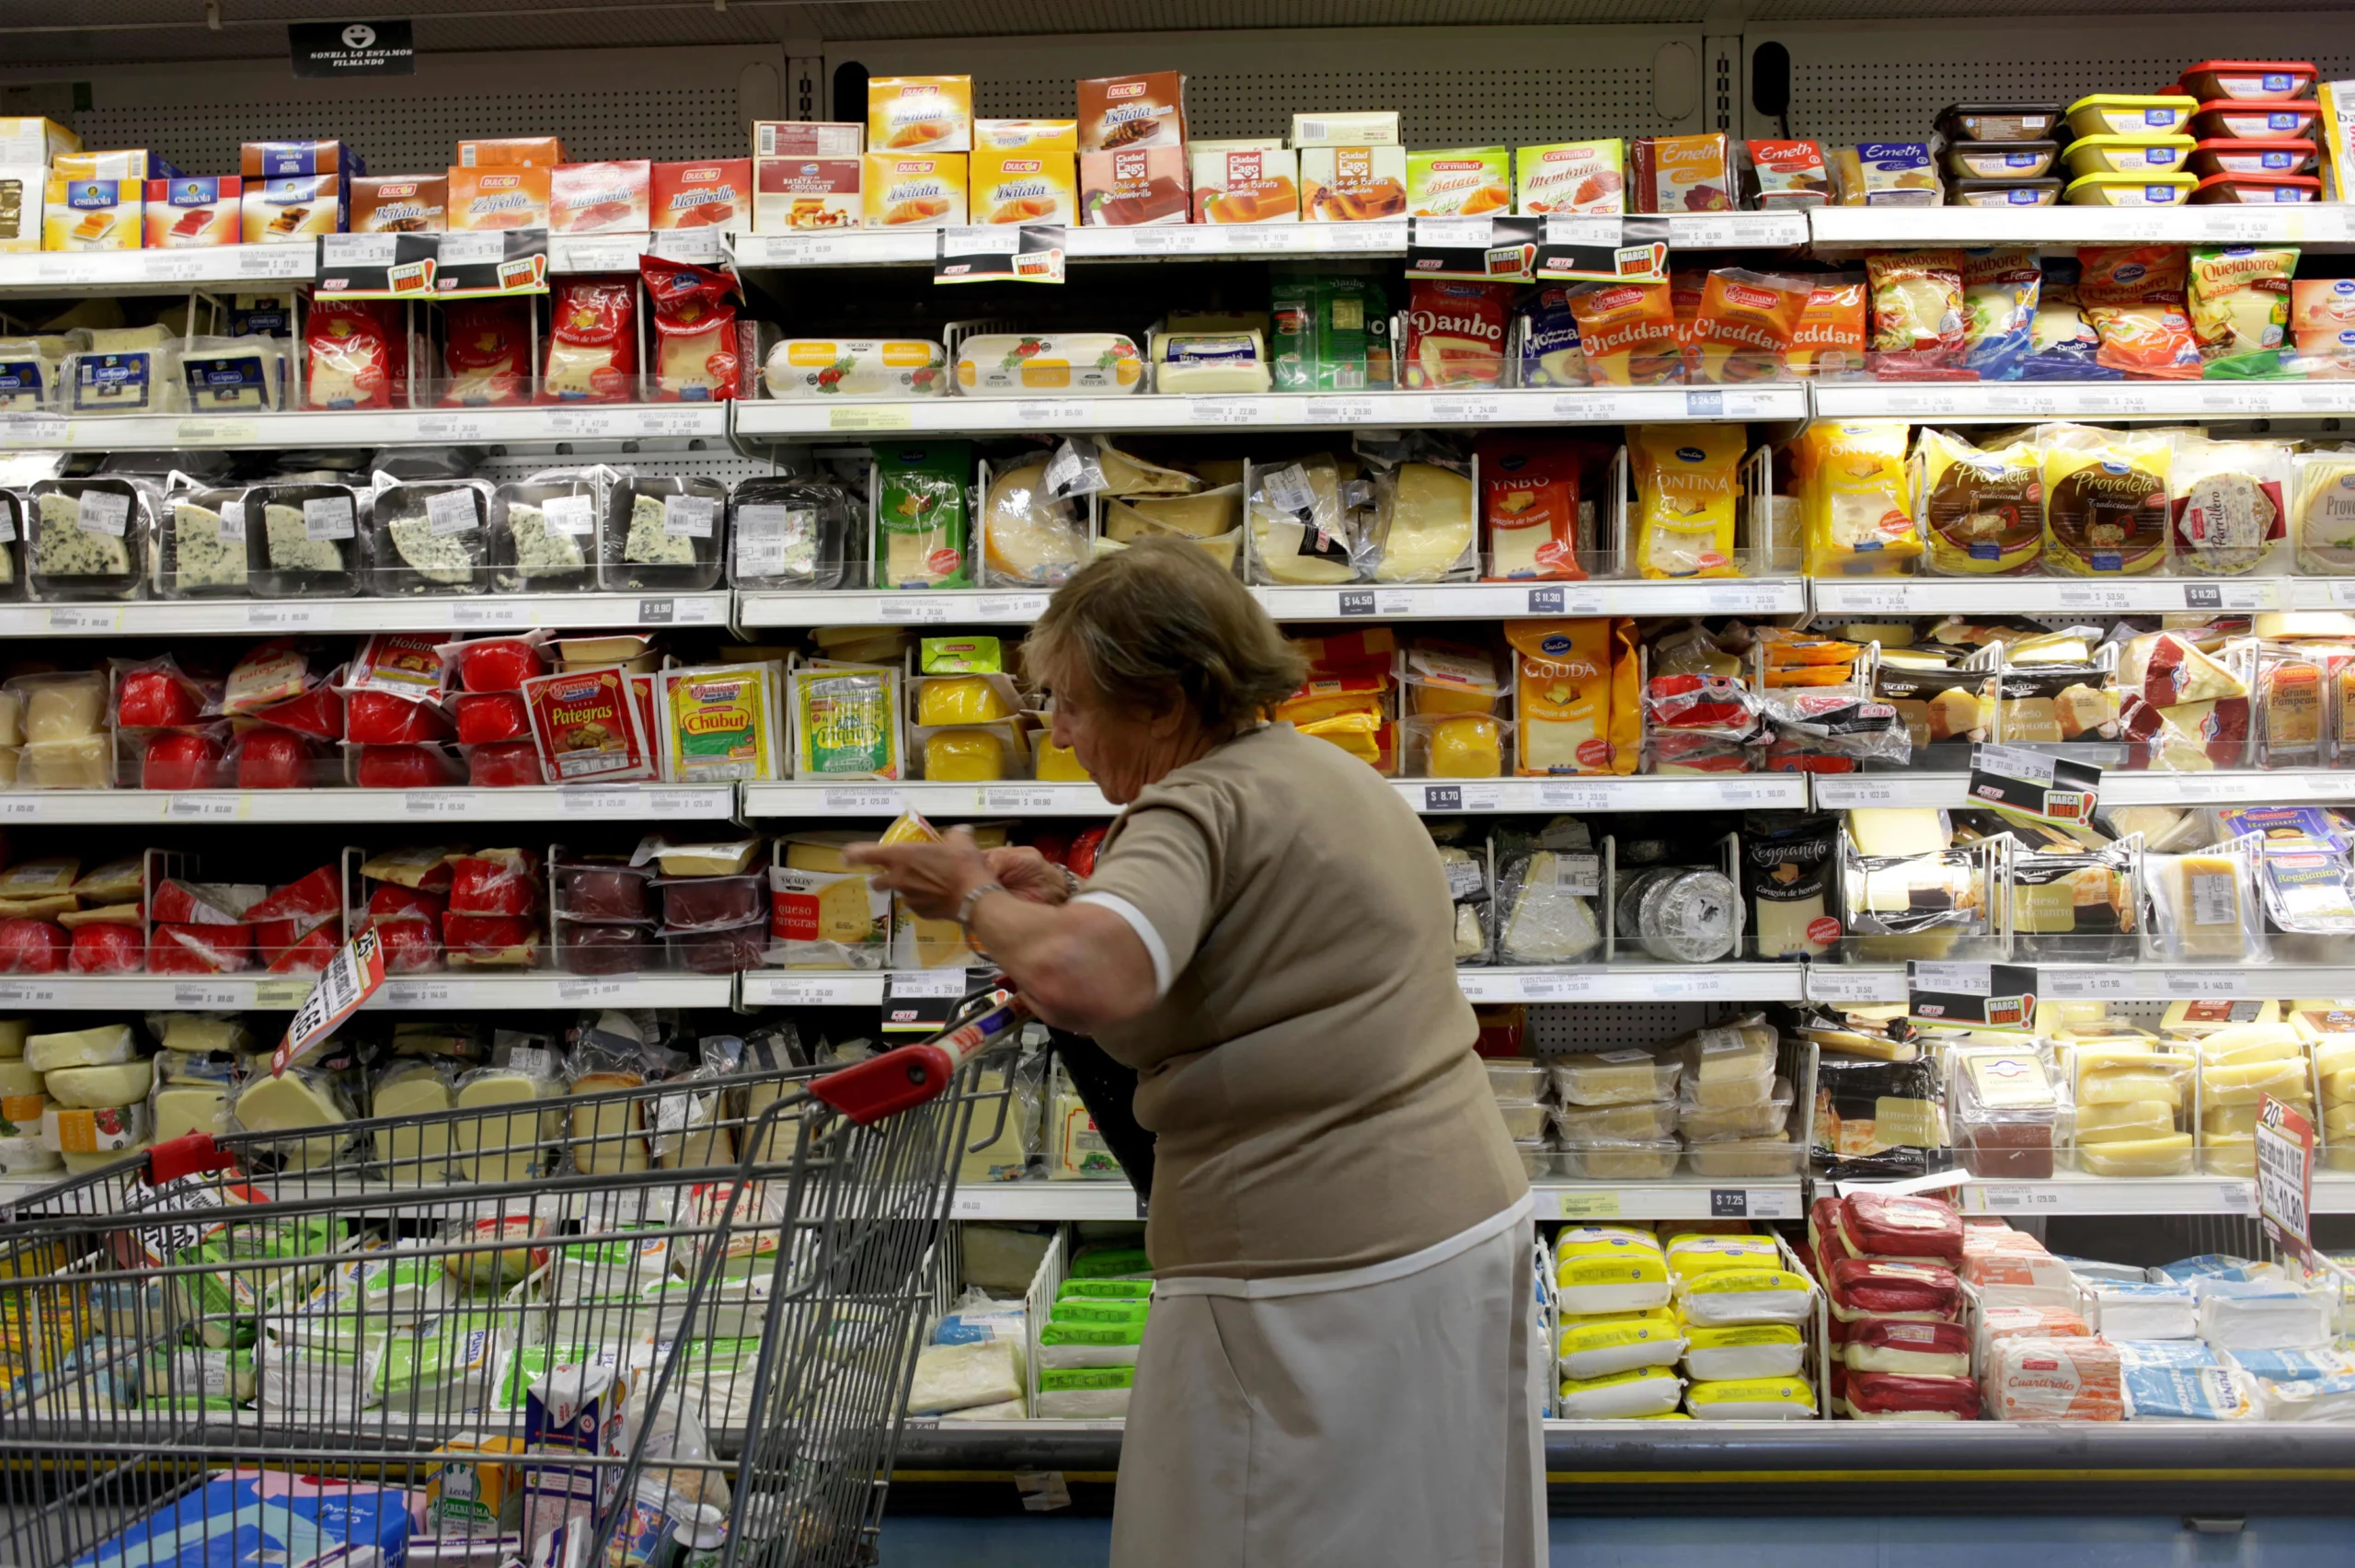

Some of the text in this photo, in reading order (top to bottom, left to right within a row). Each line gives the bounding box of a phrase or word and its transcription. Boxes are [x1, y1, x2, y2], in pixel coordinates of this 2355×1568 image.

[366, 49, 412, 57] ESTAMOS
[1104, 106, 1151, 126] Batata
[1117, 153, 1144, 163] Ciudad
[1338, 152, 1367, 161] Ciudad
[1662, 143, 1721, 164] Emeth
[1759, 143, 1812, 161] Emeth
[1865, 143, 1921, 161] Emeth
[1230, 155, 1258, 164] Ciudad
[1117, 162, 1145, 176] Lago
[1231, 163, 1258, 177] Lago
[1338, 160, 1368, 173] Lago
[1347, 177, 1388, 186] de Batata
[1527, 161, 1604, 189] Membrillo
[1114, 180, 1149, 190] Dulce de
[1236, 179, 1278, 189] de Batata
[1425, 174, 1480, 195] Batata
[175, 193, 211, 203] esnaola
[567, 186, 633, 209] Membrillo
[670, 185, 735, 209] Membrillo
[889, 185, 939, 200] Batata
[996, 184, 1046, 200] Batata
[1542, 189, 1572, 205] Light
[75, 195, 111, 206] esnaola
[470, 196, 527, 213] Zapallo
[1430, 197, 1460, 214] Light
[373, 206, 419, 222] Batata
[1016, 257, 1047, 267] MARCA
[1490, 250, 1520, 262] MARCA
[1619, 249, 1649, 262] MARCA
[394, 268, 420, 280] MARCA
[503, 263, 530, 275] MARCA
[2265, 280, 2288, 291] Fetas
[2279, 303, 2288, 313] 10
[1411, 310, 1502, 341] Danbo
[1580, 323, 1674, 357] Cheddar
[1693, 317, 1787, 350] Cheddar
[1794, 325, 1861, 345] eddar
[1691, 396, 1721, 405] $ 24.50
[1648, 474, 1730, 493] FONTINA
[2073, 471, 2154, 497] Provoleta
[1970, 489, 2023, 501] Tradicional
[2086, 498, 2141, 510] Tradicional
[1525, 509, 1550, 524] horma
[2211, 491, 2227, 549] Parrillero
[1344, 595, 1373, 606] $ 14.50
[1534, 592, 1560, 602] $ 11.30
[2190, 589, 2217, 599] $ 11.20
[645, 603, 672, 613] $ 9.90
[1523, 661, 1597, 679] GOUDA
[2281, 687, 2312, 699] Grana
[553, 703, 613, 726] Pategras
[1528, 703, 1594, 718] Corazón de horma
[687, 714, 749, 733] Chubut
[2034, 769, 2051, 780] 31.50
[1430, 790, 1458, 801] $ 8.70
[1767, 789, 1786, 797] 90.00
[2049, 794, 2078, 807] MARCA
[2278, 869, 2338, 883] Reggianito
[1754, 880, 1822, 897] Corazón de horma
[778, 905, 812, 918] queso
[355, 929, 375, 958] 25
[944, 985, 963, 994] 29.90
[1567, 982, 1589, 990] 235.00
[1988, 1000, 2020, 1013] MARCA
[2262, 1101, 2280, 1129] 20
[1716, 1195, 1744, 1206] $ 7.25
[2036, 1195, 2057, 1203] 129.00
[2008, 1375, 2074, 1391] Cuartirolo
[2217, 1369, 2236, 1410] PUNTA
[449, 1486, 472, 1497] Leche
